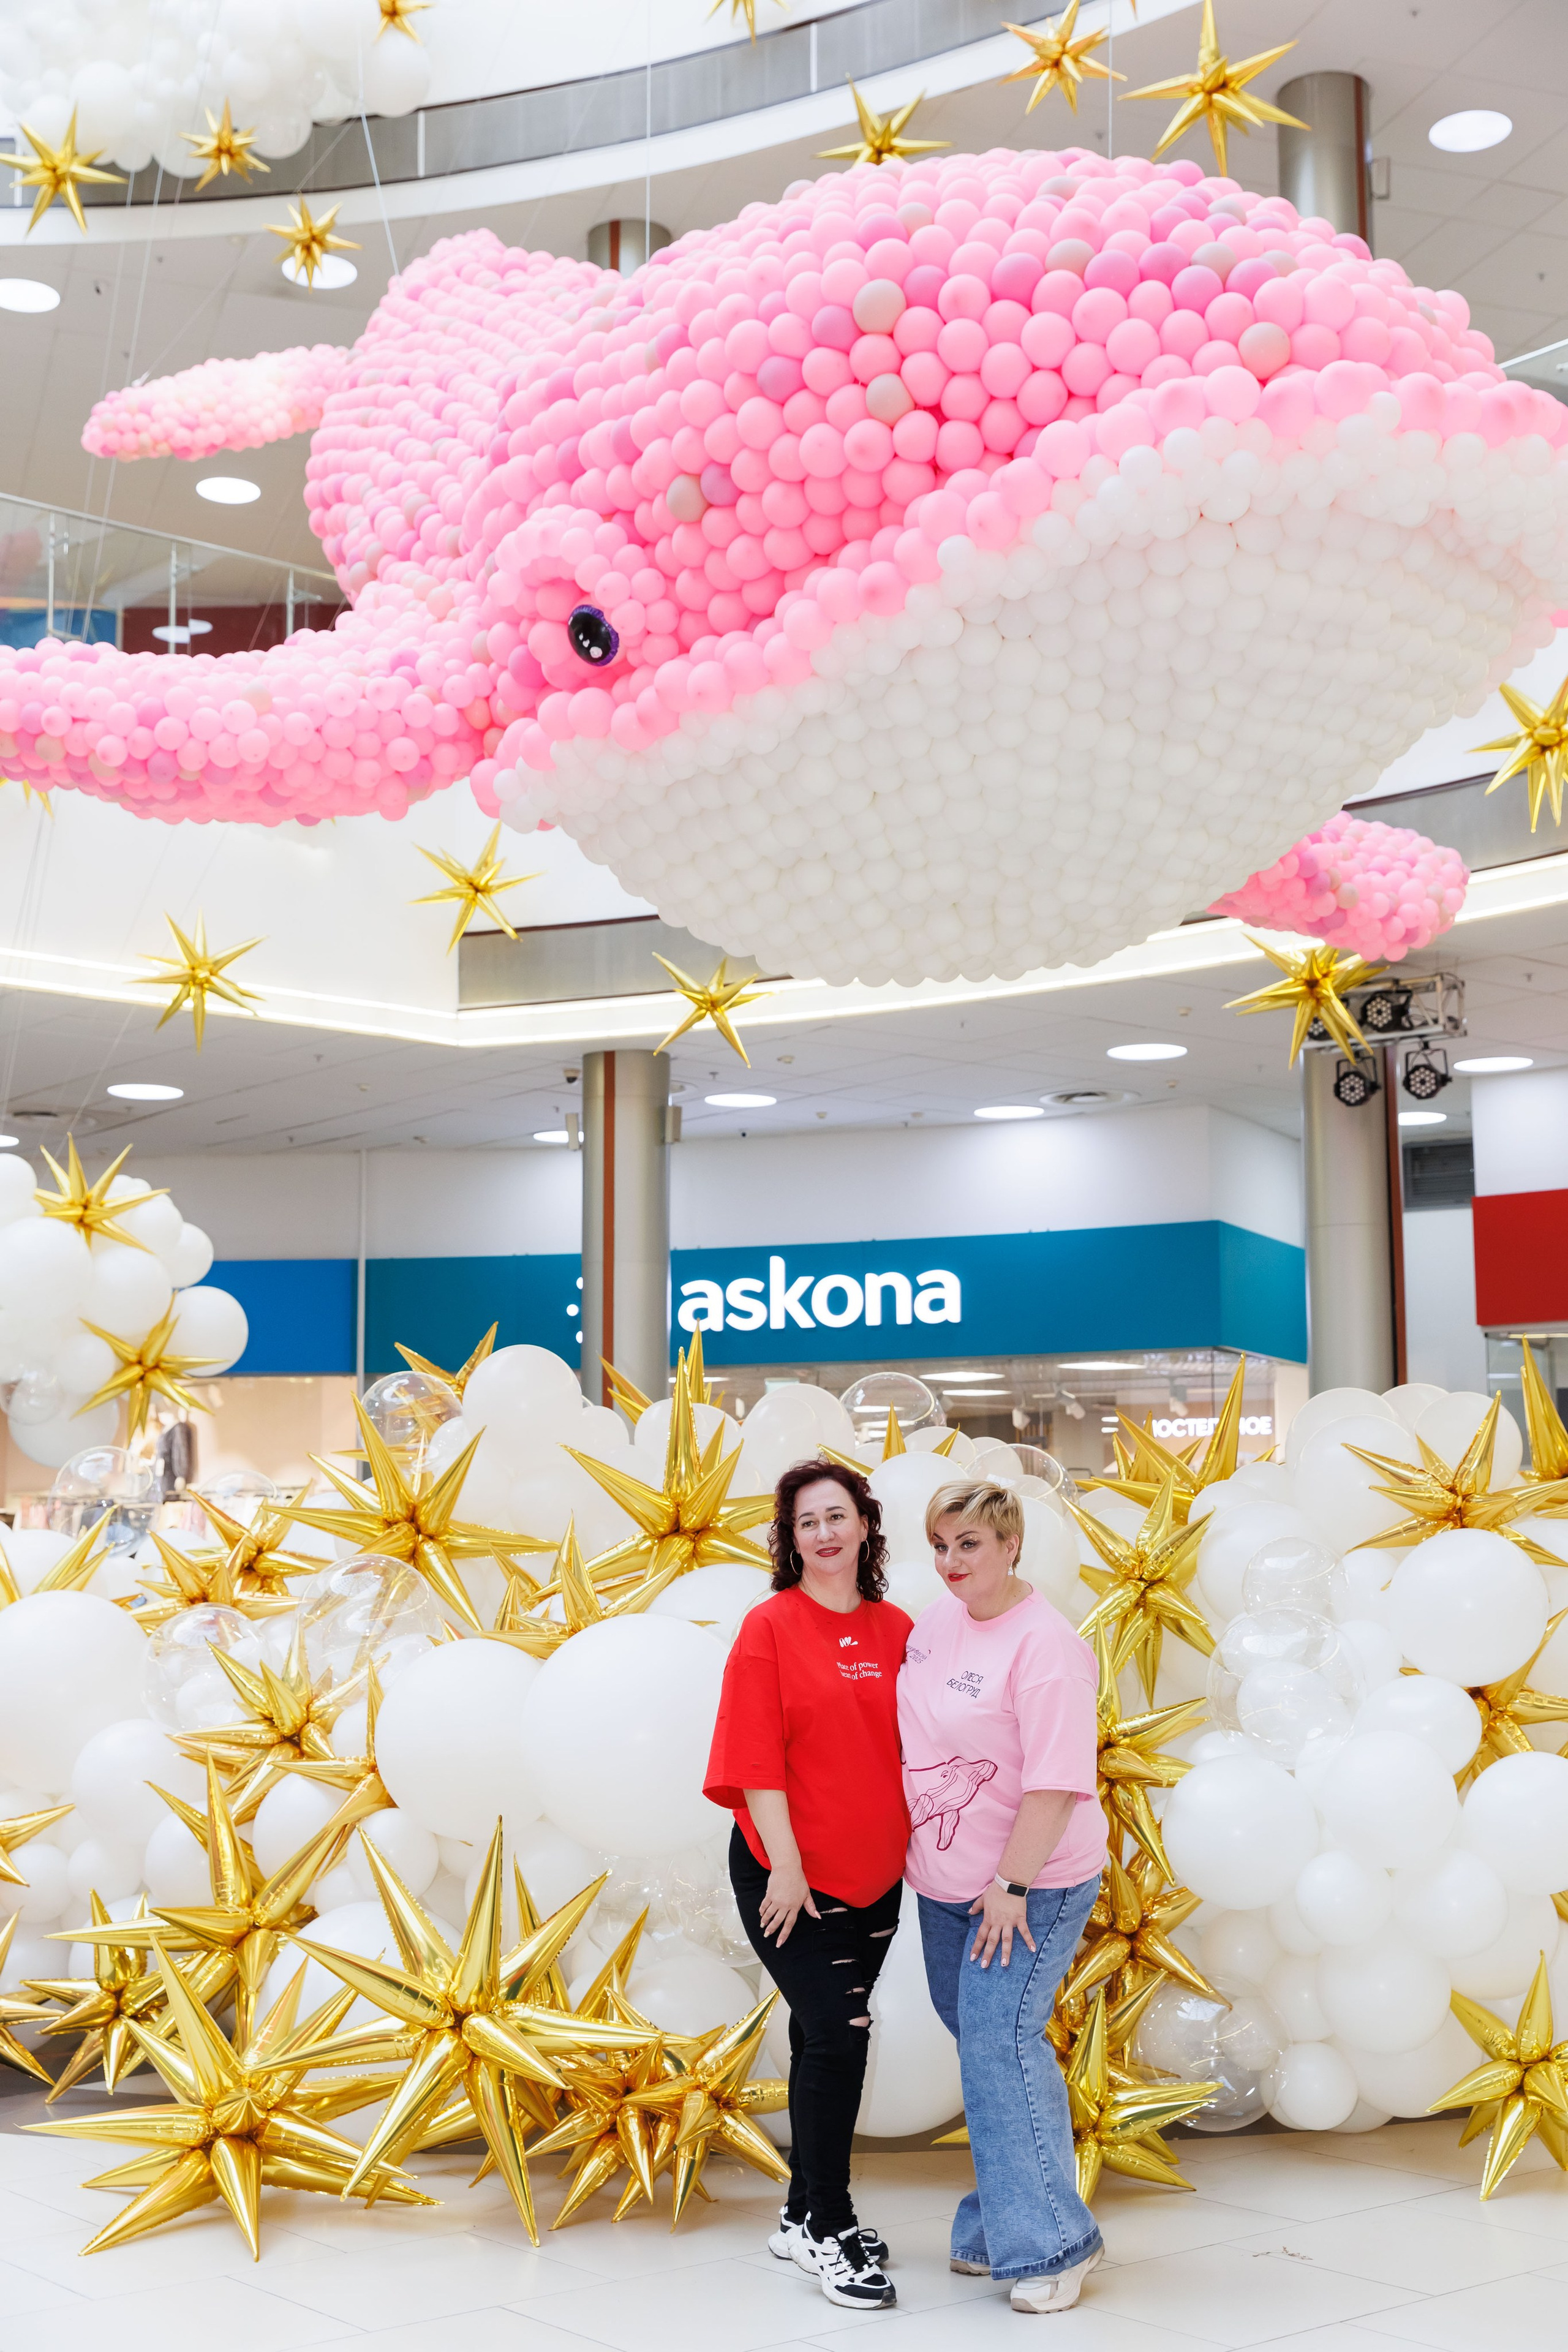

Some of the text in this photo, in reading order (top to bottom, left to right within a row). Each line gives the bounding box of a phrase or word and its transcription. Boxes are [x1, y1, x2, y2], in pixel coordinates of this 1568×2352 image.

[678, 1256, 961, 1332] askona
[909, 1654, 924, 1664] 2025
[850, 1662, 857, 1671] of
[858, 1662, 878, 1671] power
[851, 1672, 858, 1680] of
[859, 1670, 883, 1678] change
[961, 1670, 984, 1685] ОЛЕСЯ
[946, 1678, 981, 1698] БЕЛОГРУД
